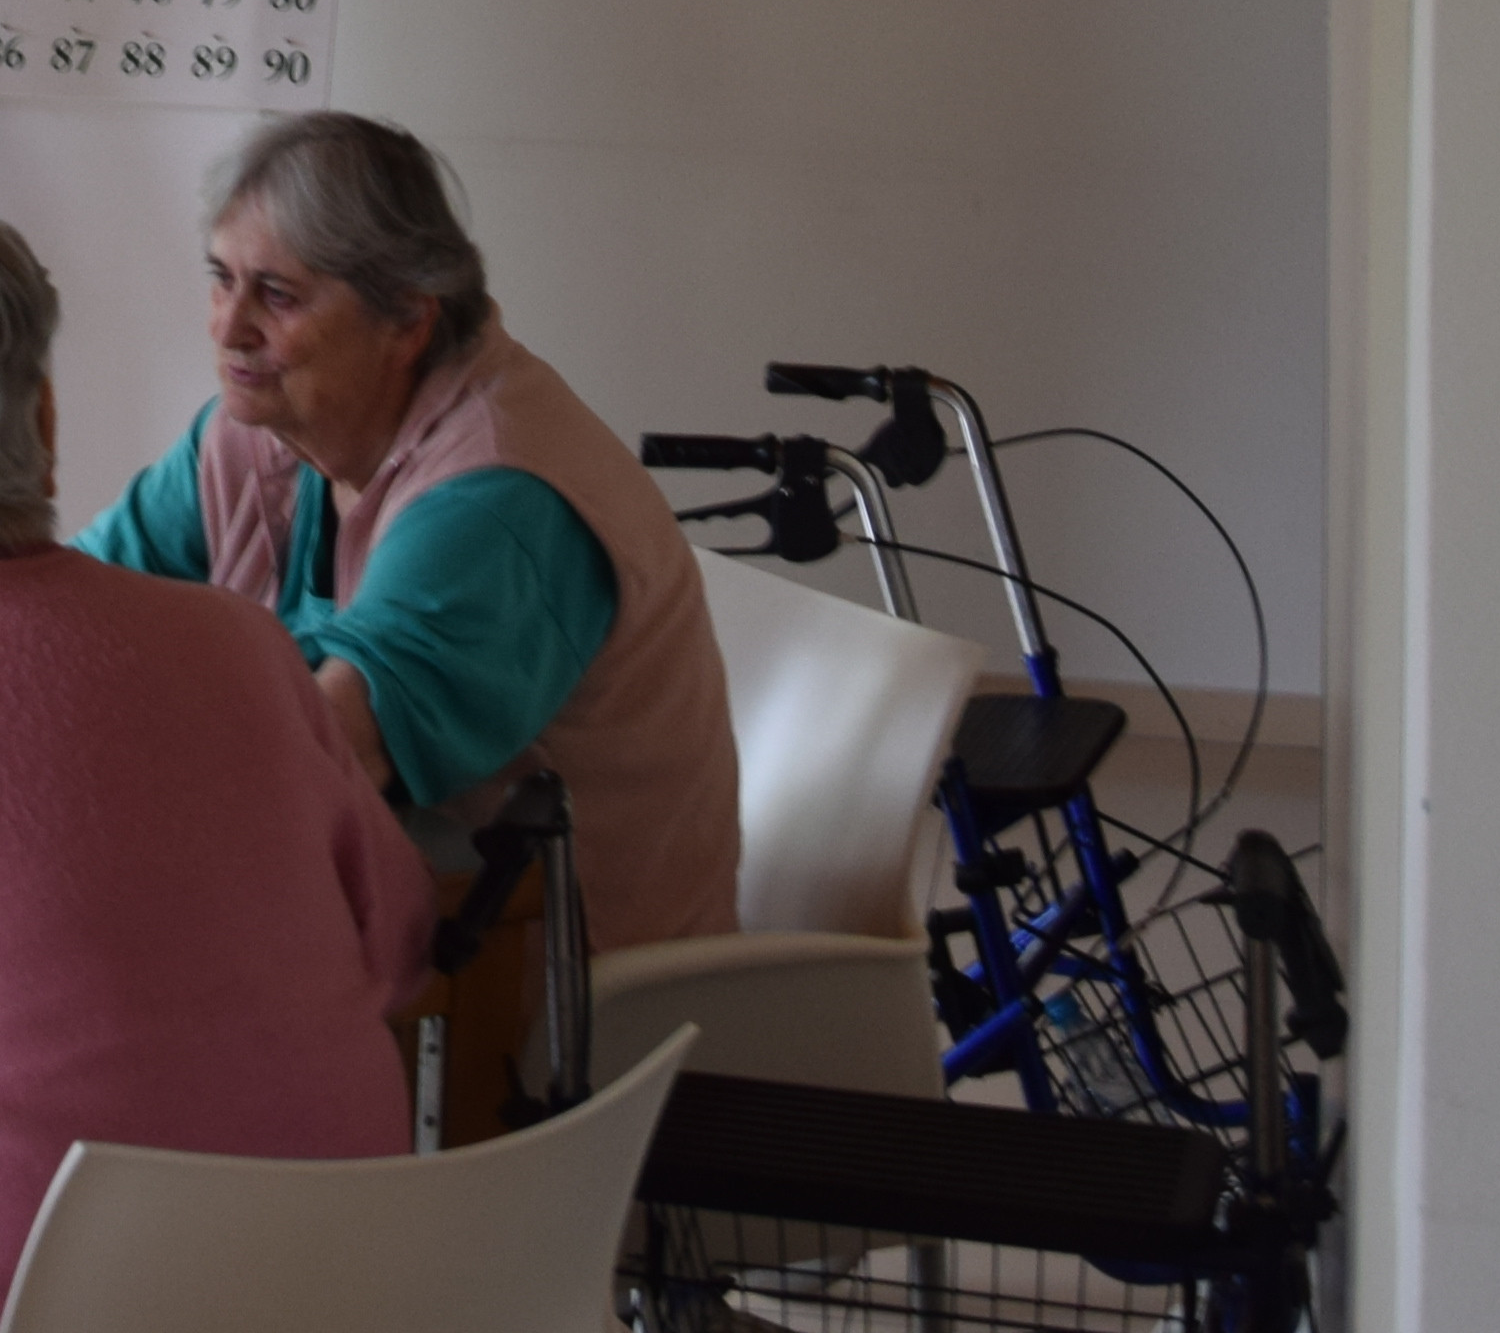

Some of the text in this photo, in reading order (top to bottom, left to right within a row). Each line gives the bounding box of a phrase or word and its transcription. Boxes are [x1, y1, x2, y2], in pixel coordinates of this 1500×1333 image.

[49, 38, 97, 74] 87
[118, 41, 166, 77] 88
[190, 45, 239, 80] 89
[262, 48, 311, 86] 90
